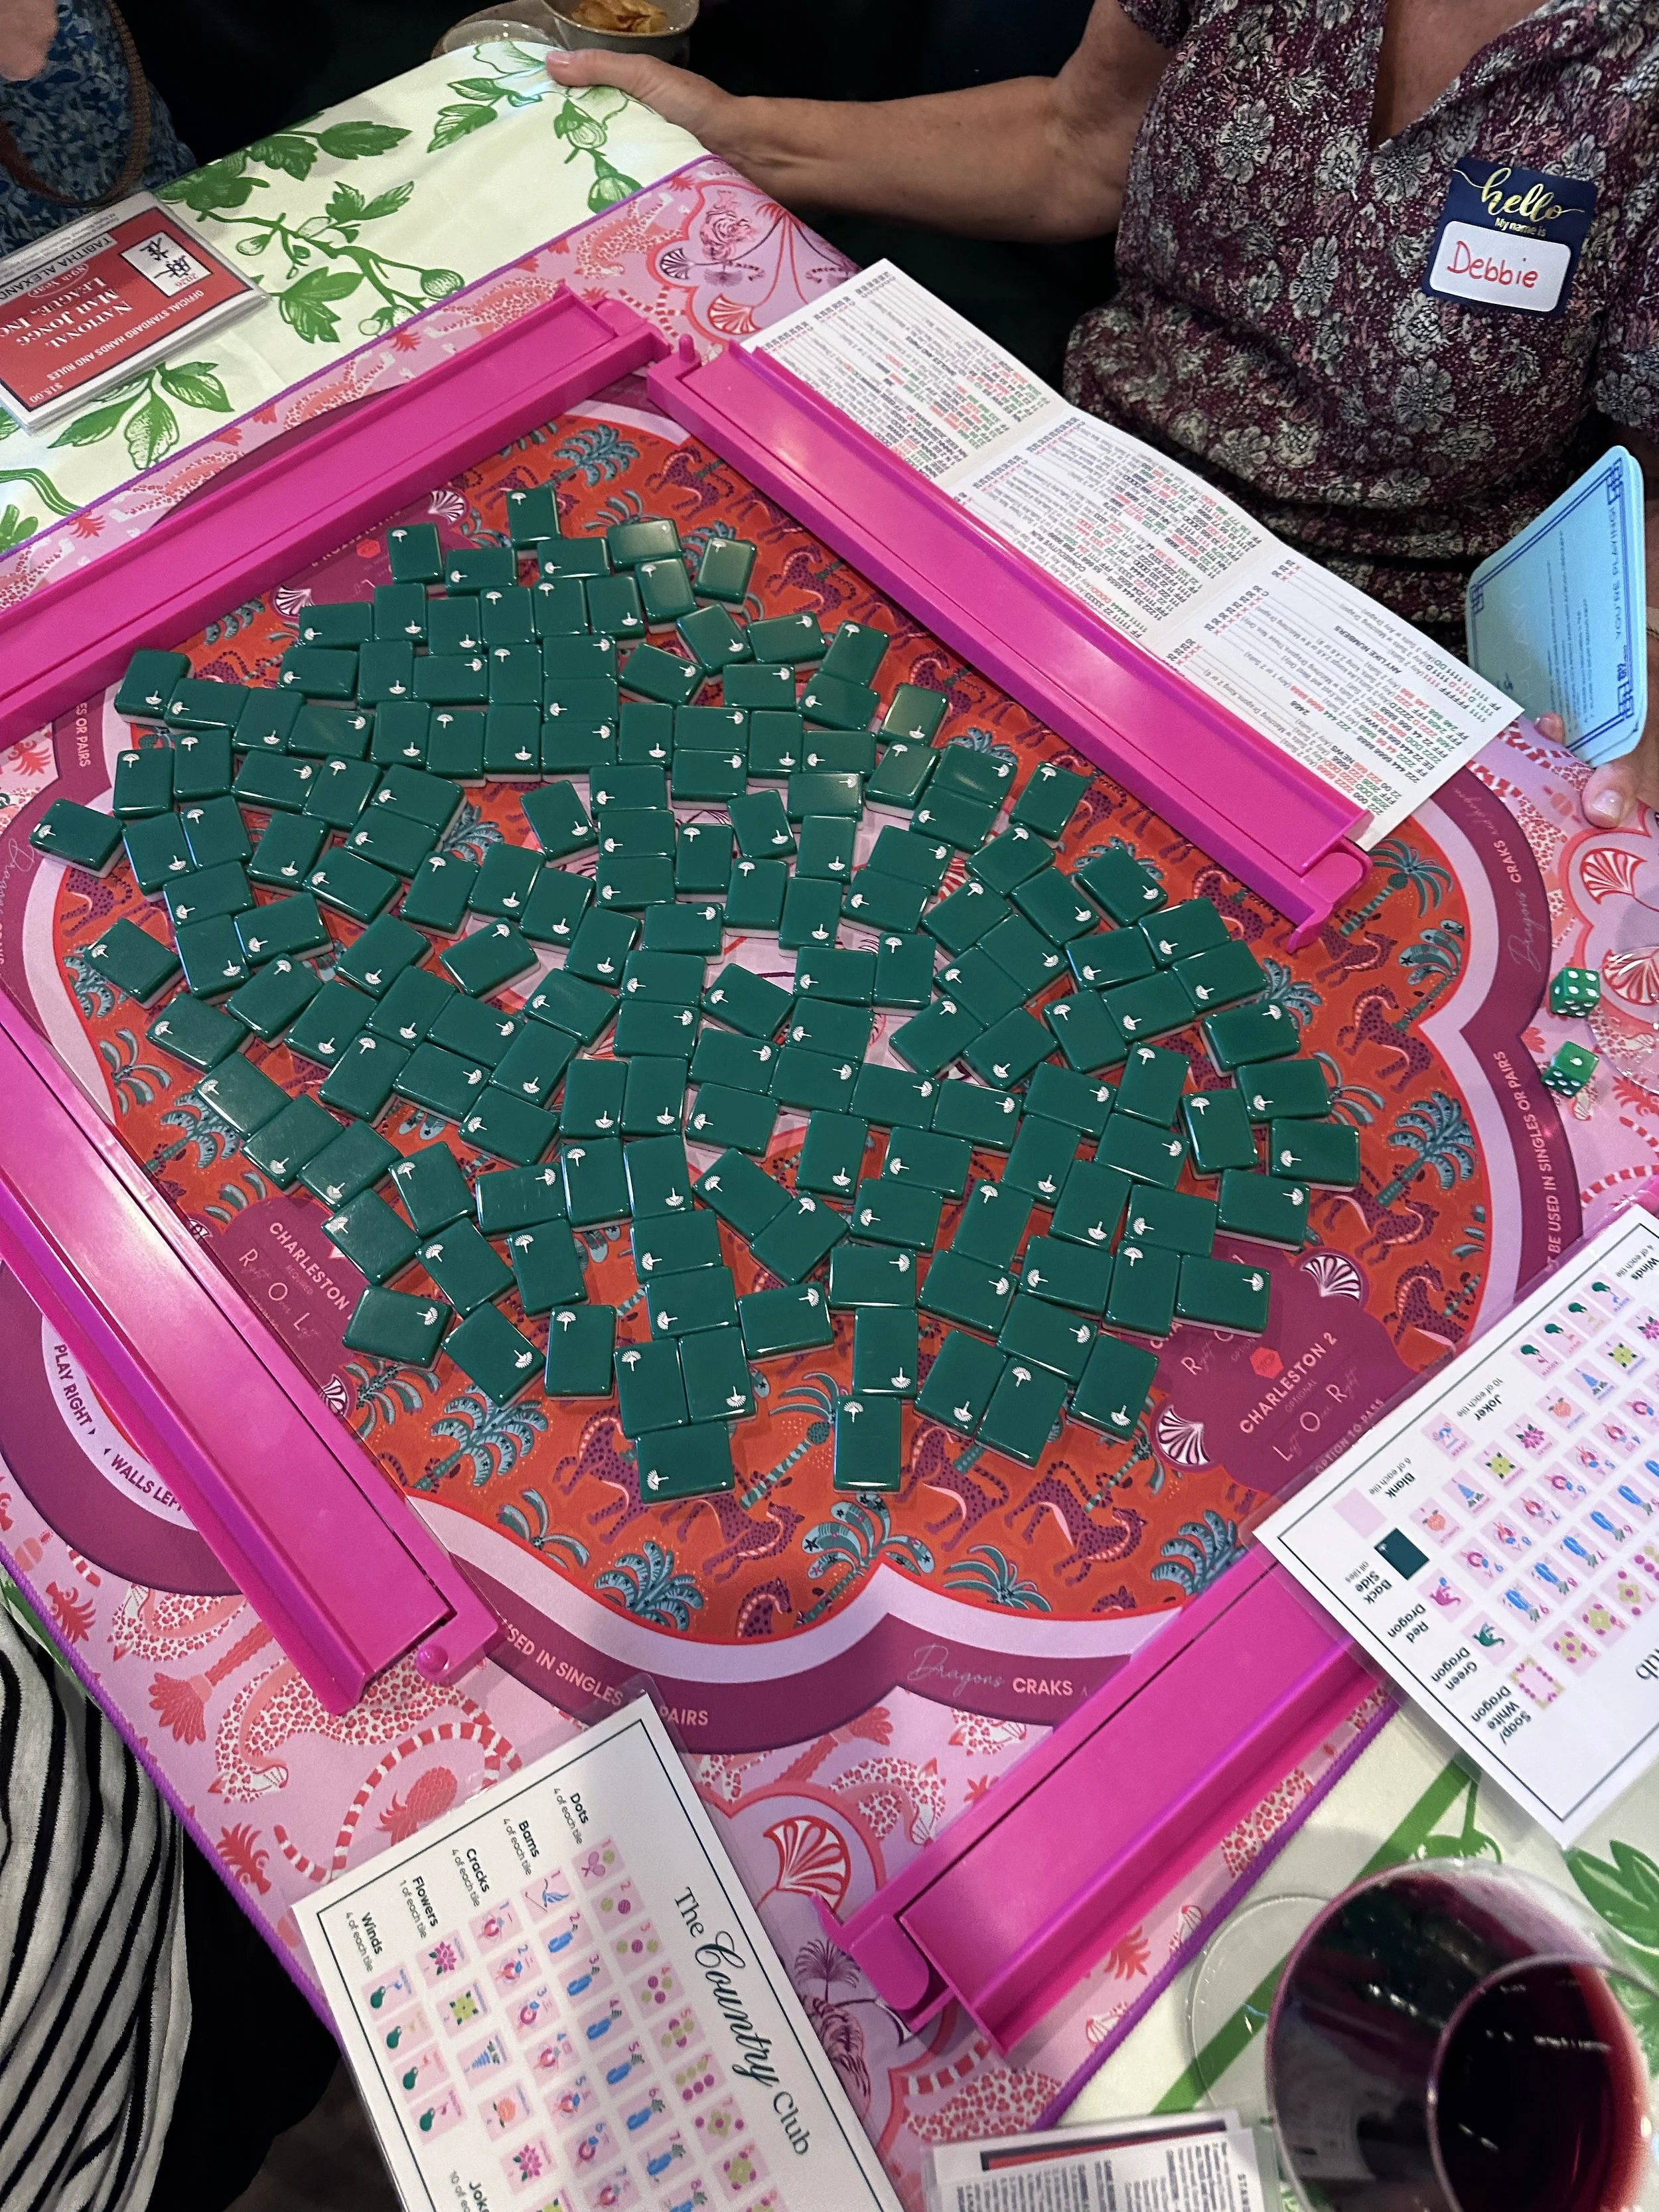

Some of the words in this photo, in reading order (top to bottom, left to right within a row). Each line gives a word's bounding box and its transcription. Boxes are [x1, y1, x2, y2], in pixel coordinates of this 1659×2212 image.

[1468, 168, 1571, 222] hello
[1495, 218, 1510, 232] My
[1509, 222, 1538, 235] name
[1539, 226, 1547, 237] is
[58, 237, 111, 269] TABITHA
[1447, 241, 1539, 288] Debbie
[75, 287, 119, 319] MAH
[171, 290, 204, 315] OFFICIAL
[15, 311, 75, 346] JONGG
[45, 300, 132, 348] NATIONAL
[125, 310, 170, 339] STANDARD
[95, 334, 126, 356] HANDS
[47, 361, 76, 380] RULES
[75, 351, 95, 367] AND
[30, 383, 64, 403] $15.00
[1043, 539, 1086, 572] CONSECUTIVE
[1333, 625, 1370, 652] NUMBERS
[1367, 650, 1386, 663] LIKE
[1383, 661, 1402, 674] ANY
[76, 717, 89, 735] OR
[77, 737, 92, 768] PAIRS
[1330, 745, 1355, 763] NEWS
[1347, 768, 1364, 779] 222
[1366, 773, 1382, 783] 222
[1391, 762, 1406, 773] 444
[1404, 772, 1420, 782] 222
[1333, 778, 1354, 792] 2222
[1352, 792, 1369, 804] 000
[1366, 803, 1384, 814] 222
[1378, 792, 1397, 804] FFF
[1493, 840, 1522, 883] CRAKS
[1493, 1051, 1522, 1089] PAIRS
[1514, 1090, 1531, 1112] OR
[1523, 1114, 1552, 1172] SINGLES
[1541, 1175, 1557, 1191] IN
[1546, 1194, 1561, 1232] USED
[1548, 1236, 1561, 1254] BE
[1638, 1247, 1650, 1259] of
[269, 1222, 350, 1310] CHARLESTON
[1615, 1264, 1630, 1279] tile
[1625, 1253, 1642, 1270] each
[1630, 1254, 1659, 1284] Winds
[54, 1344, 74, 1380] PLAY
[64, 1383, 92, 1426] RIGHT
[1240, 1342, 1327, 1434] CHARLESTON
[1323, 1331, 1338, 1346] 2
[1483, 1383, 1494, 1394] of
[1491, 1376, 1503, 1387] 10
[1455, 1404, 1470, 1419] tile
[1465, 1389, 1487, 1410] each
[1472, 1392, 1504, 1422] Joker
[1314, 1436, 1350, 1475] OPTION
[1348, 1423, 1363, 1439] TO
[111, 1454, 155, 1493] WALLS
[1377, 1467, 1398, 1487] each
[1395, 1461, 1406, 1472] of
[1367, 1482, 1382, 1496] tile
[1384, 1470, 1415, 1501] Blank
[1343, 1567, 1361, 1584] tiles
[1358, 1560, 1370, 1572] all
[1353, 1569, 1381, 1595] Side
[1362, 1578, 1393, 1607] Back
[1384, 1601, 1427, 1639] Dragon
[1404, 1620, 1430, 1644] Red
[506, 1624, 536, 1655] SED
[535, 1649, 556, 1670] IN
[555, 1662, 624, 1706] SINGLES
[1428, 1645, 1471, 1684] Dragon
[1443, 1659, 1479, 1692] Green
[1012, 1676, 1073, 1696] CRAKS
[1467, 1683, 1512, 1724] Dragon
[1484, 1699, 1520, 1732] White
[1502, 1710, 1532, 1745] Soap/
[555, 1794, 566, 1806] of
[570, 1792, 590, 1824] Dots
[502, 1816, 510, 1825] 4
[560, 1805, 576, 1830] each
[505, 1824, 516, 1836] of
[518, 1820, 541, 1858] Bams
[571, 1828, 584, 1846] tile
[510, 1835, 526, 1861] each
[465, 1847, 492, 1893] Cracks
[521, 1859, 533, 1876] tile
[401, 1885, 411, 1898] of
[453, 1855, 464, 1868] of
[459, 1867, 474, 1892] each
[469, 1890, 481, 1907] tile
[405, 1897, 421, 1923] each
[411, 1875, 441, 1927] Flowers
[344, 1910, 354, 1919] 4
[348, 1918, 358, 1931] of
[360, 1911, 386, 1955] Winds
[415, 1921, 429, 1939] tile
[352, 1930, 368, 1956] each
[362, 1954, 376, 1973] tile
[674, 1887, 706, 1937] The
[695, 1931, 780, 2089] Country
[772, 2091, 808, 2156] Club
